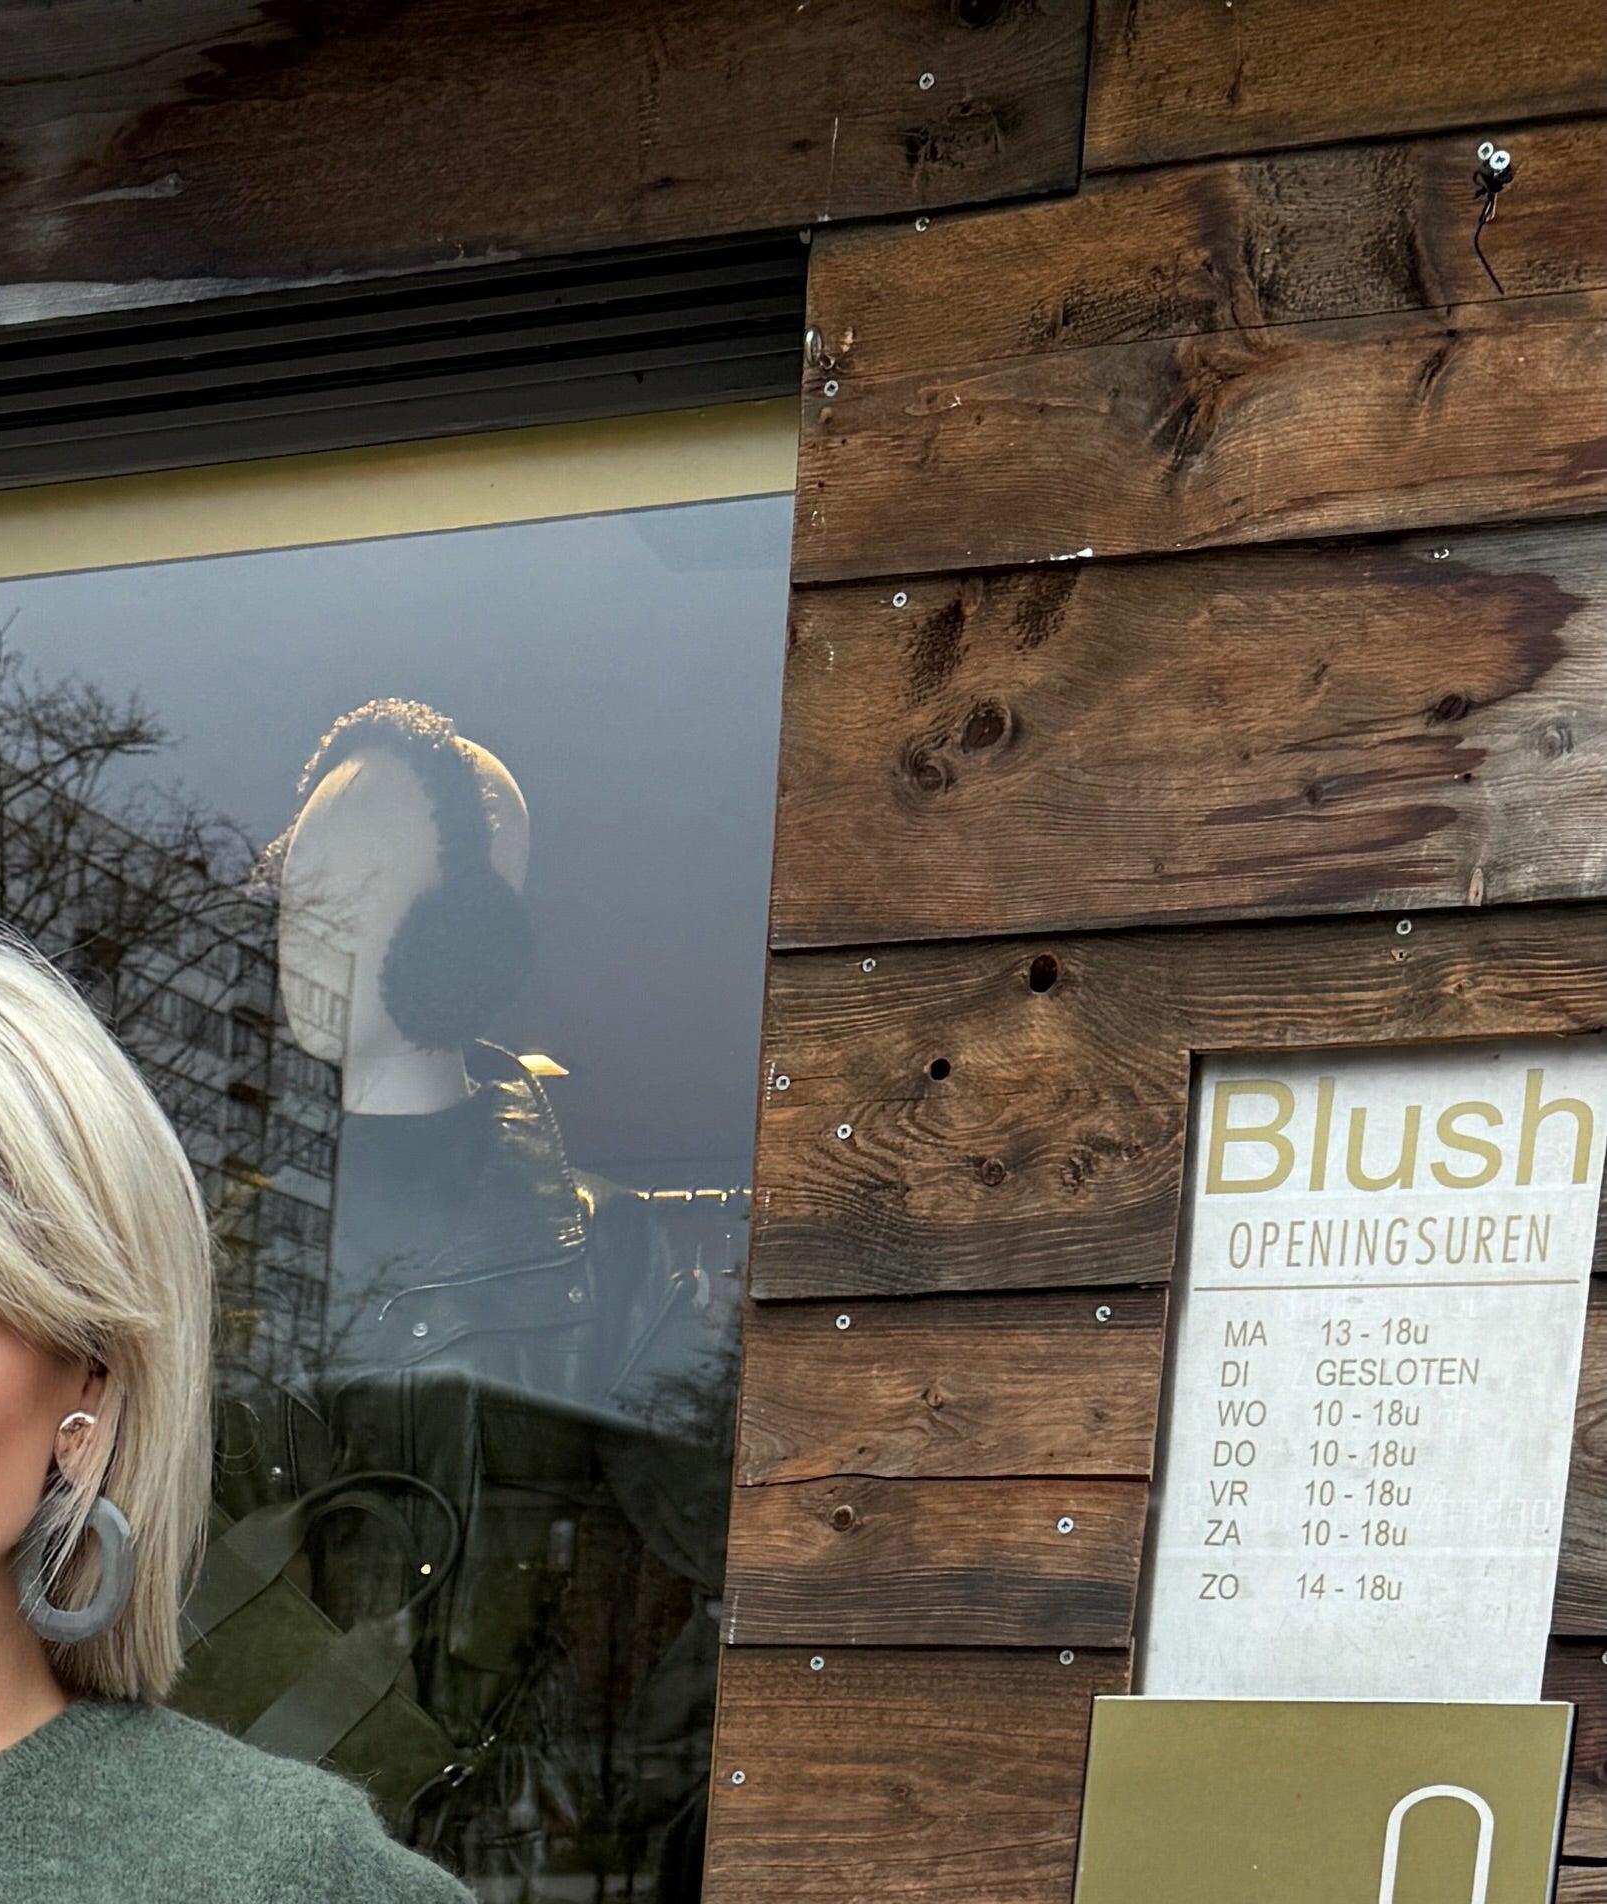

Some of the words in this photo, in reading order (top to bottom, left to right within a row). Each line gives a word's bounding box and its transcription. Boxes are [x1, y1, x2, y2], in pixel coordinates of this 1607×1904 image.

[1205, 1068, 1594, 1195] Blush
[1228, 1213, 1551, 1270] OPENINGSUREN
[1224, 1319, 1268, 1348] MA
[1321, 1318, 1352, 1347] 13
[1381, 1317, 1430, 1346] 18u
[1220, 1360, 1250, 1388] DI
[1315, 1357, 1480, 1387] GESLOTEN
[1217, 1399, 1267, 1428] WO
[1313, 1399, 1343, 1427] 10
[1372, 1399, 1420, 1427] 18u
[1213, 1439, 1256, 1468] DO
[1309, 1439, 1339, 1467] 10
[1369, 1439, 1417, 1468] 18u
[1209, 1479, 1249, 1507] VR
[1305, 1479, 1335, 1507] 10
[1365, 1479, 1412, 1507] 18u
[1203, 1519, 1242, 1547] ZA
[1301, 1519, 1331, 1547] 10
[1361, 1519, 1407, 1547] 18u
[1198, 1572, 1240, 1600] ZO
[1297, 1573, 1326, 1600] 14
[1355, 1574, 1403, 1602] 18u
